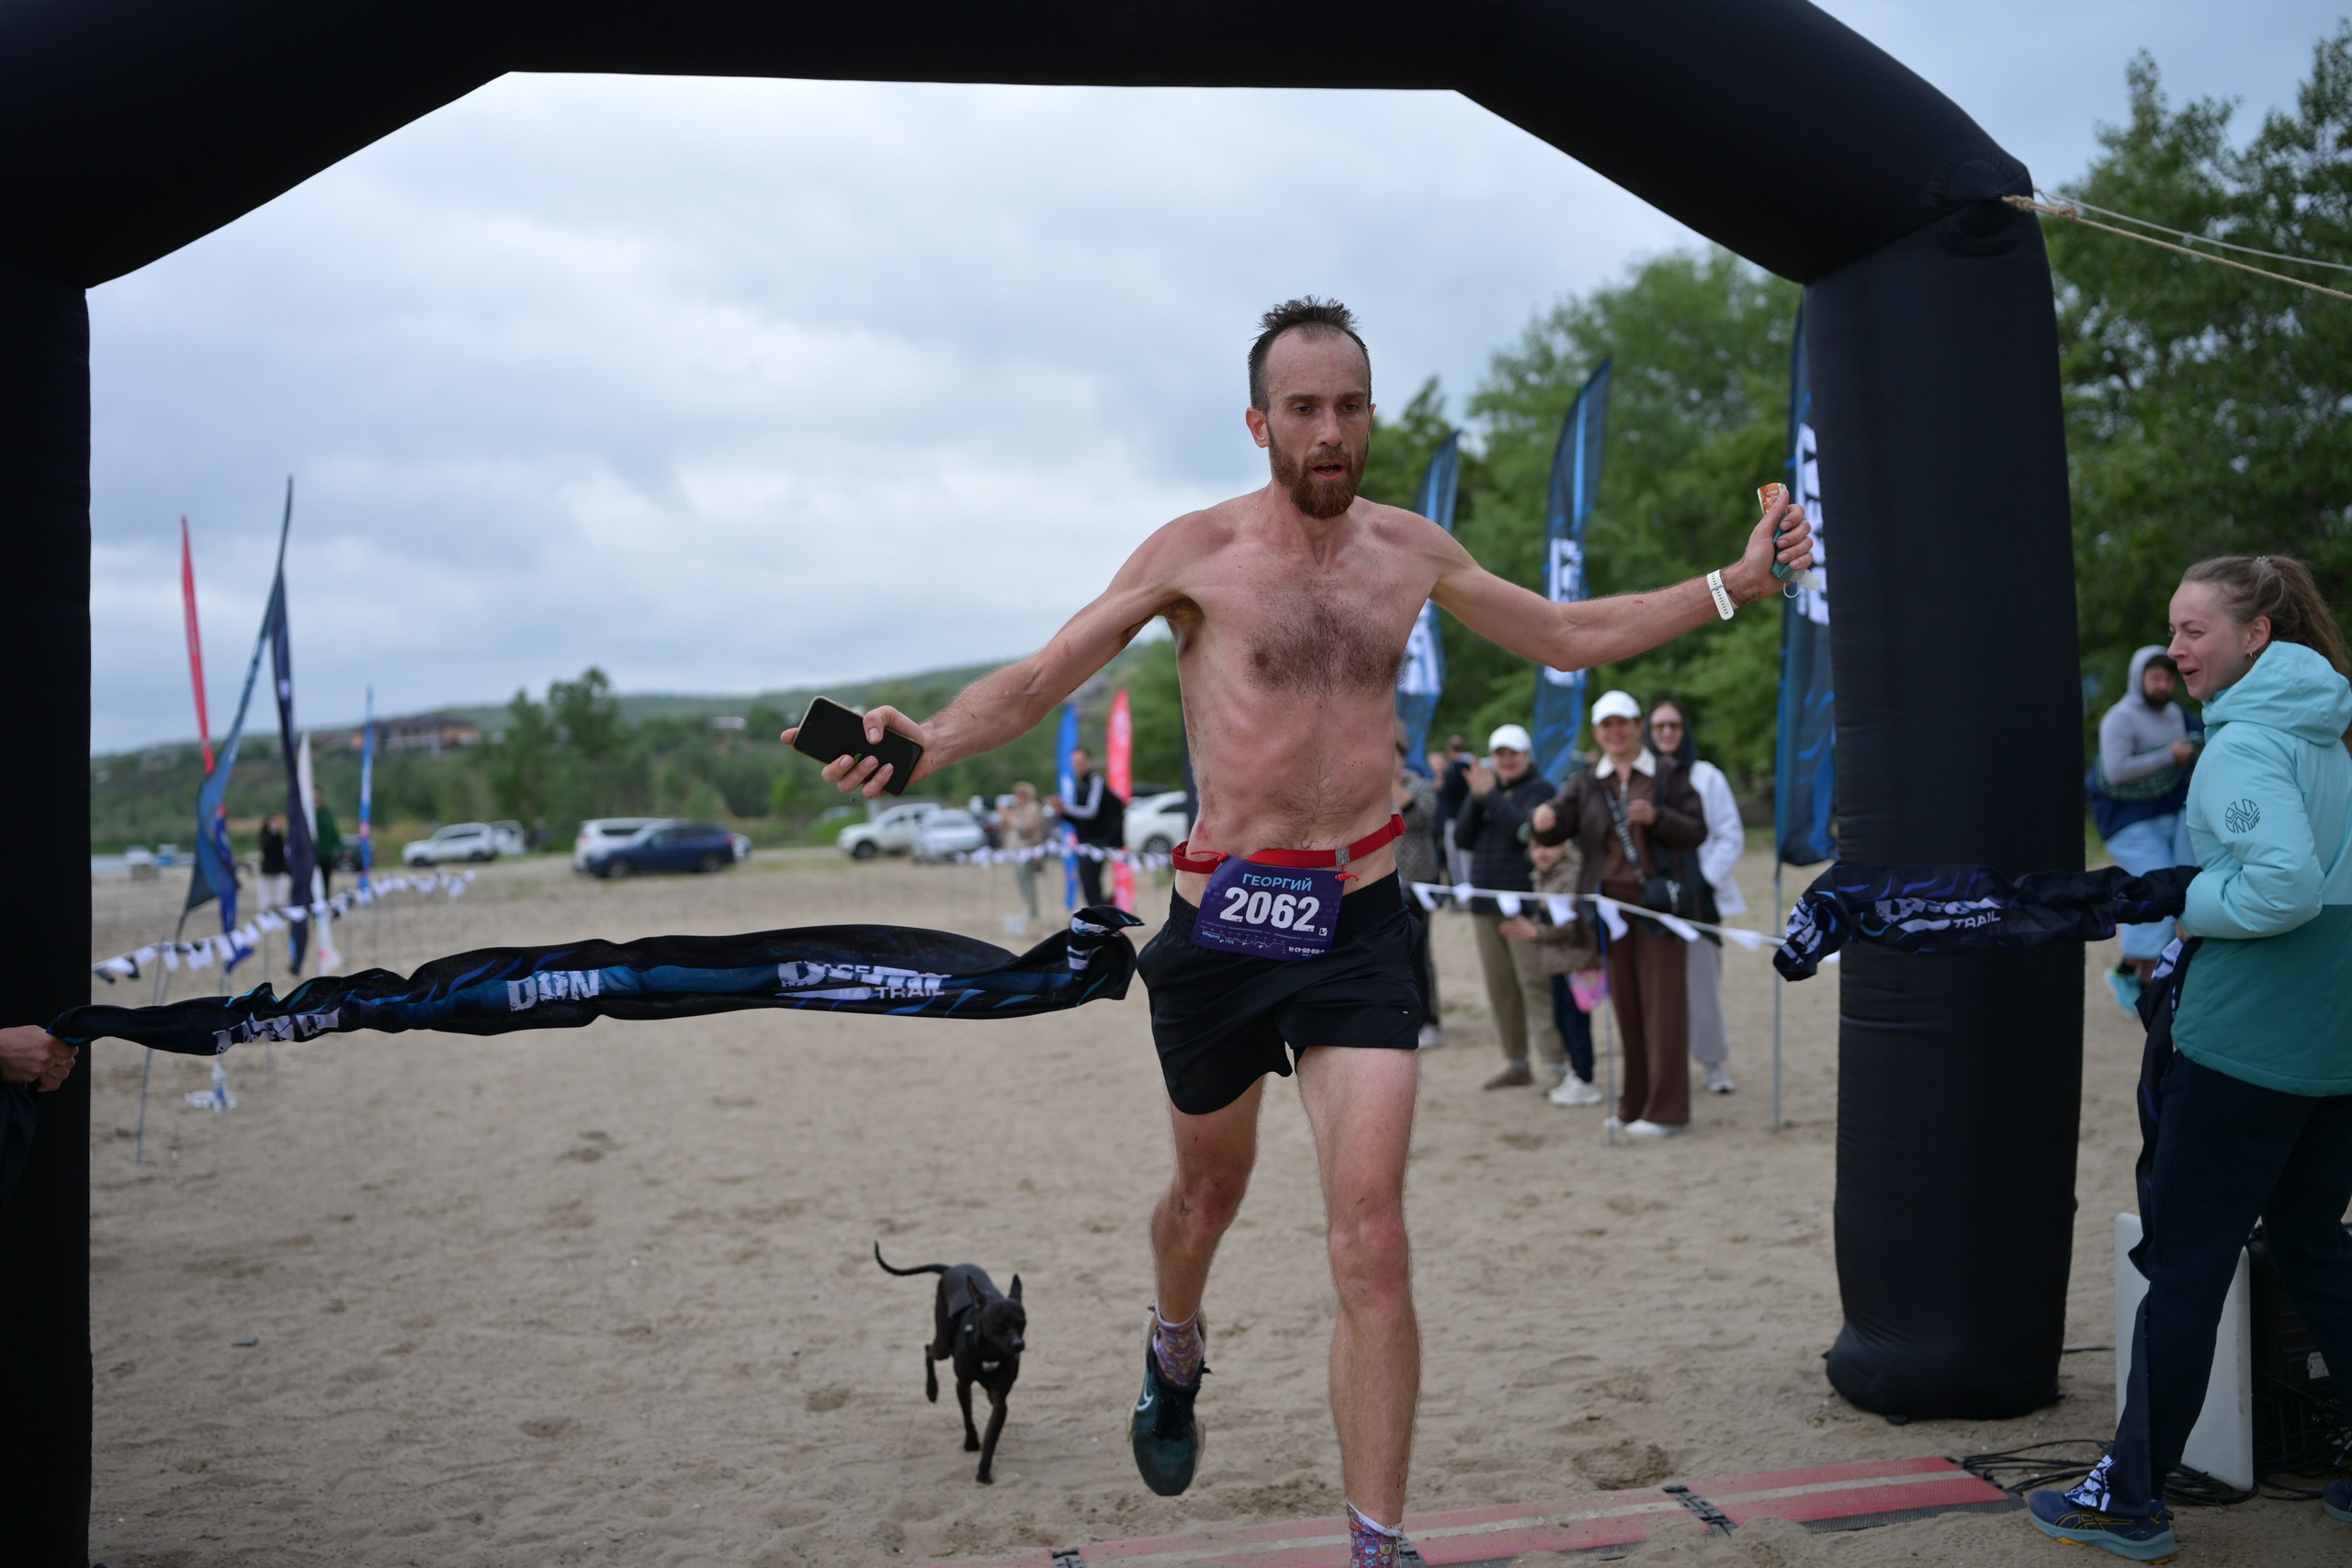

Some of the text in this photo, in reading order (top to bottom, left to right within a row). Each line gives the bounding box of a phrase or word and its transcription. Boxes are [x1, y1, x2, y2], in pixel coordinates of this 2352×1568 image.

[1242, 873, 1313, 892] ГЕОРГИЙ
[1219, 886, 1320, 932] 2062
[1953, 910, 2002, 929] TRAIL
[506, 968, 600, 1011] DON
[875, 986, 945, 999] TRAIL
